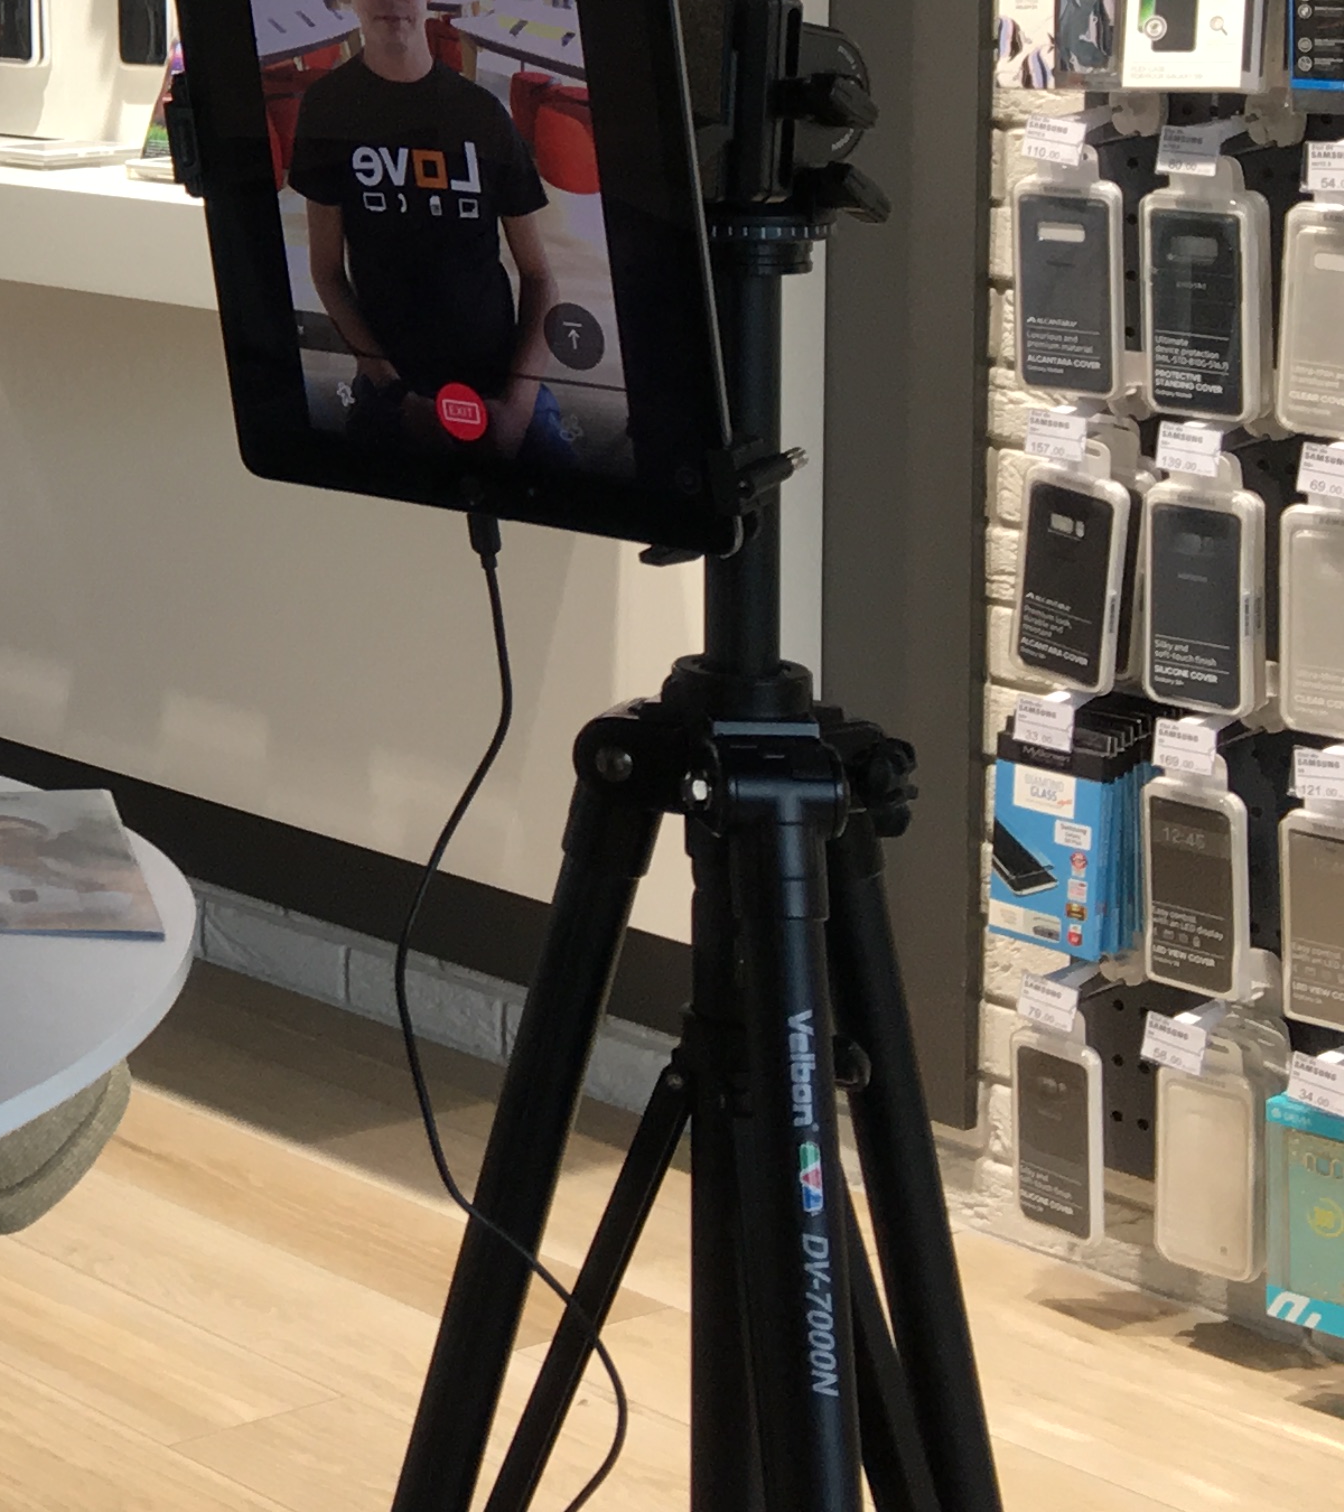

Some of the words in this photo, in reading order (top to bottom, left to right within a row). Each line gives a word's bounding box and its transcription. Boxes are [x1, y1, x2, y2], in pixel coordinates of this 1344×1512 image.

[1026, 356, 1073, 368] ALCANTARA
[1074, 359, 1102, 370] COVER
[1154, 368, 1203, 383] PROTECTIVE
[1154, 378, 1195, 391] STANDING
[1196, 382, 1224, 394] COVER
[448, 403, 475, 419] EXIT
[1030, 417, 1071, 430] SAMSUNG
[1161, 430, 1204, 444] SAMSUNG
[1063, 650, 1089, 667] COVER
[1154, 665, 1189, 679] SILICONE
[1190, 670, 1218, 684] COVER
[1018, 704, 1057, 719] SAMSUNG
[1158, 728, 1200, 743] SAMSUNG
[1297, 757, 1341, 769] SAMSUNG
[1030, 786, 1058, 802] GLASS
[1188, 952, 1216, 968] COVER
[1024, 979, 1063, 1000] SAMSUNG
[1149, 1020, 1189, 1042] SAMSUNG
[787, 1009, 818, 1128] Velbon
[1294, 1061, 1337, 1082] SAMSUNG
[801, 1233, 839, 1397] DV-7000N
